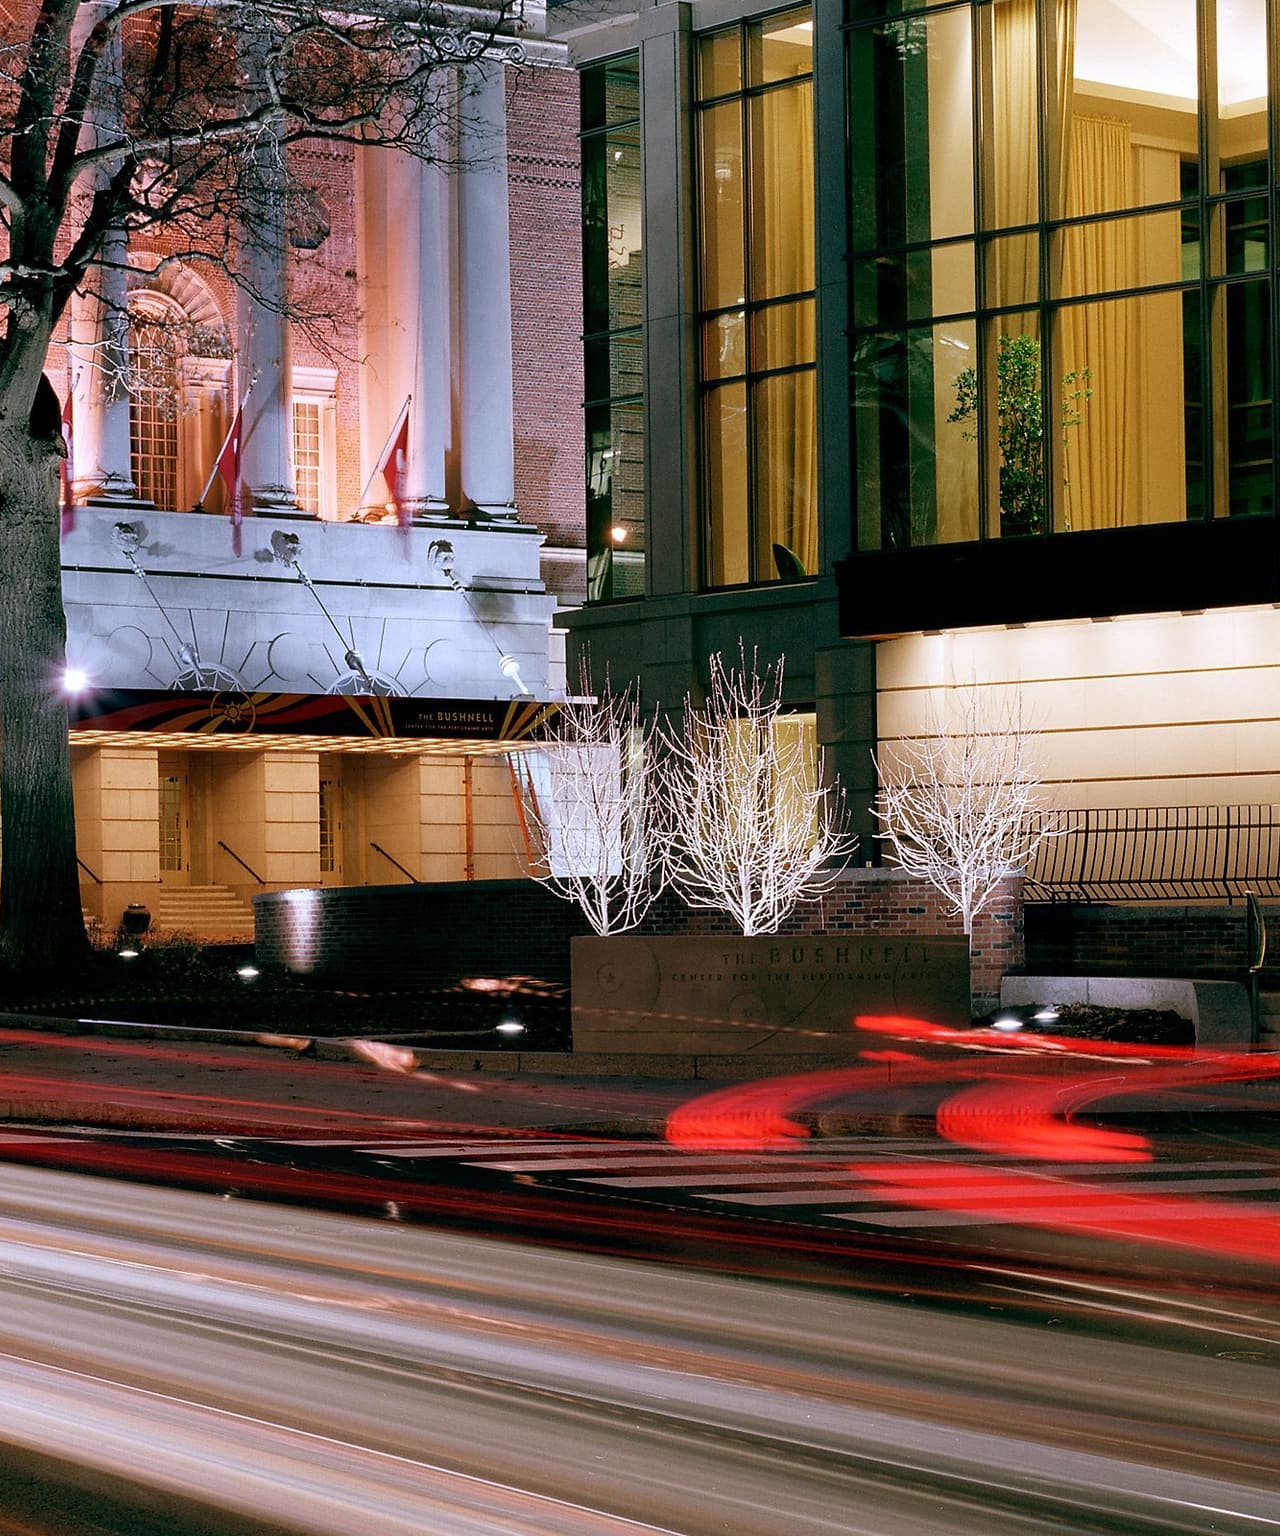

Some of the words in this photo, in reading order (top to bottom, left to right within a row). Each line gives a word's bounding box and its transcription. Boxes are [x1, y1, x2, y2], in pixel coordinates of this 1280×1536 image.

[418, 713, 434, 721] THE
[438, 712, 494, 723] BUSHNELL
[722, 952, 758, 965] THE
[769, 946, 931, 964] BUSHNELL
[671, 973, 723, 982] CENTER
[732, 973, 757, 982] FOR
